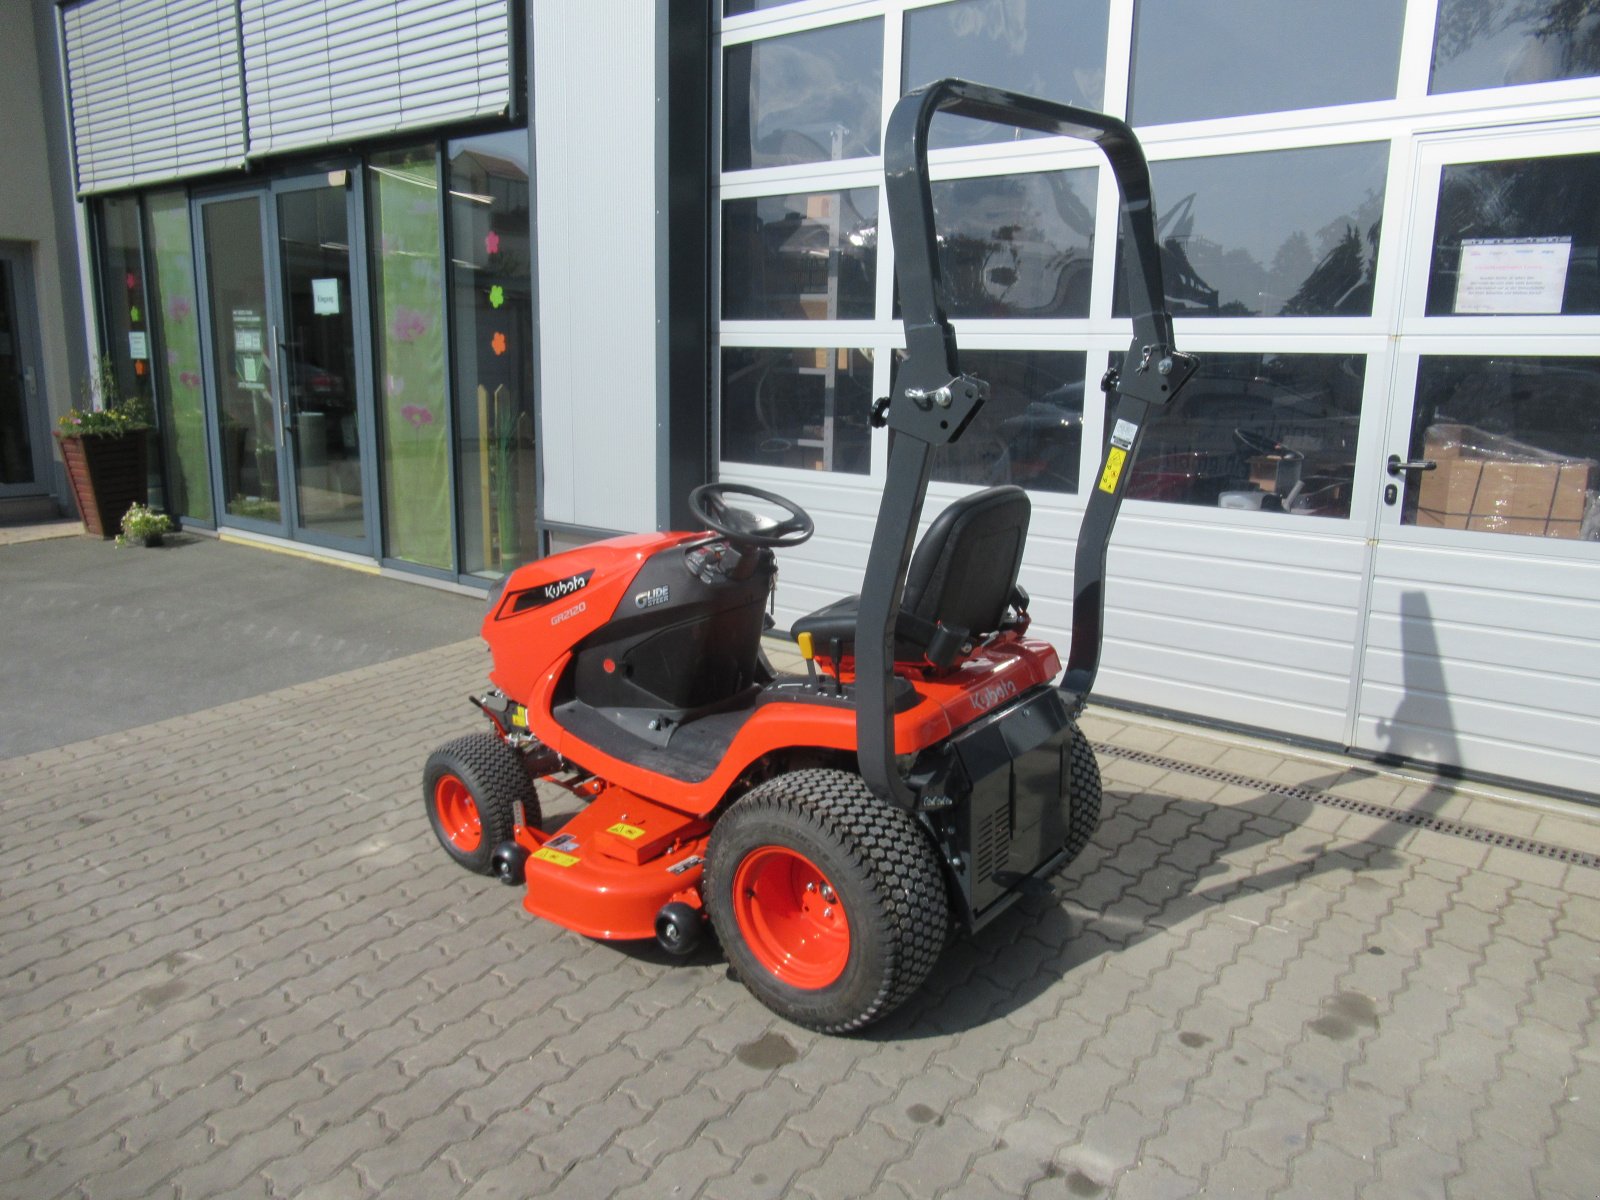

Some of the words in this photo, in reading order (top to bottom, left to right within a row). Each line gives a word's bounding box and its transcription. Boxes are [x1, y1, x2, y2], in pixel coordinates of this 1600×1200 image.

[545, 576, 586, 598] Kubota
[551, 602, 586, 625] GR2120
[970, 679, 1017, 710] Kubota
